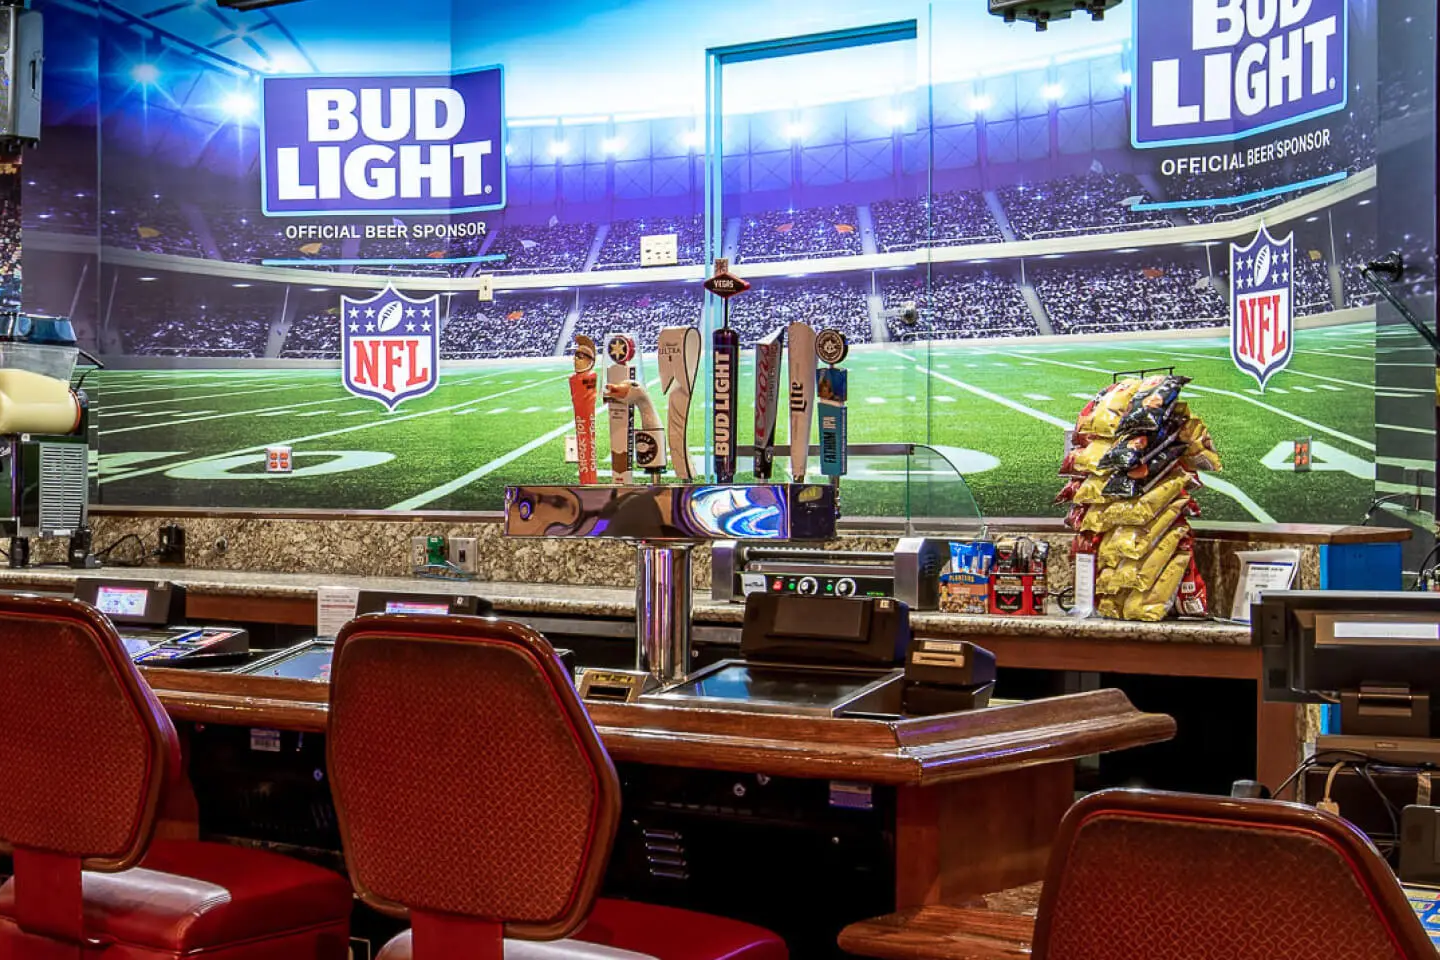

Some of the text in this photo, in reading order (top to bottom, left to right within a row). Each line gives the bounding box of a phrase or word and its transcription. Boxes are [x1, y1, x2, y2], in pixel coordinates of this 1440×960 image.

[1152, 15, 1337, 127] LIGHT
[306, 87, 466, 142] BUD
[277, 140, 492, 200] LIGHT
[1161, 129, 1330, 176] OFFICIAL BEER SPONSOR
[286, 222, 486, 239] OFFICIAL BEER SPONSOR
[713, 280, 735, 289] VEGAS
[1239, 294, 1286, 366] NFL
[353, 340, 429, 393] NFL
[714, 351, 730, 457] BUD LIGHT
[790, 381, 808, 413] Lite
[576, 415, 589, 473] SHOCK TOP
[823, 416, 837, 464] FATHOM IPA
